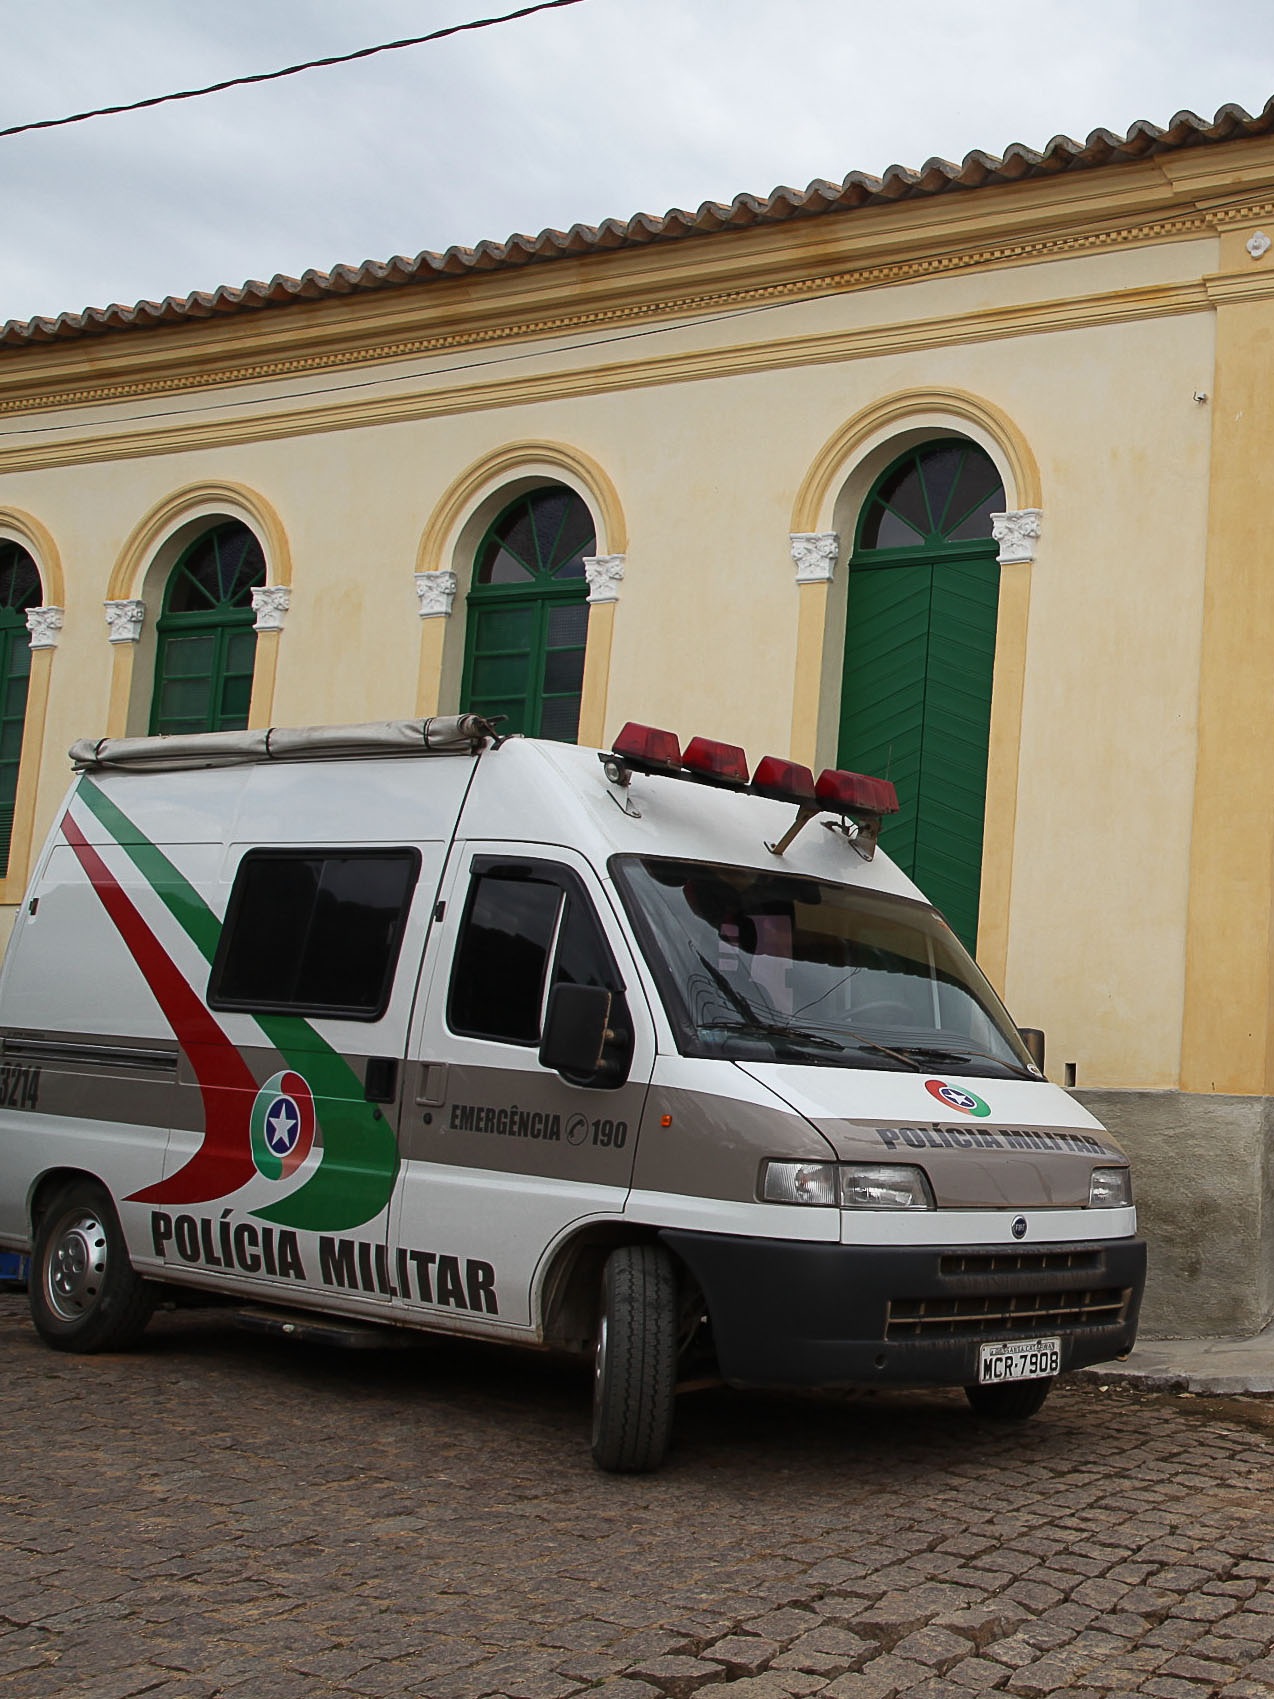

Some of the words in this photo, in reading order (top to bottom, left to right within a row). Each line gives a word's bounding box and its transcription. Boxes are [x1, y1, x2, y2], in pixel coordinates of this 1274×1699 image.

[449, 1103, 562, 1141] EMERGÊNCIA
[591, 1117, 627, 1149] 190
[876, 1122, 1000, 1151] POLÍCIA
[999, 1129, 1106, 1155] MILITAR
[150, 1208, 306, 1281] POLÍCIA
[319, 1238, 499, 1316] MILITAR
